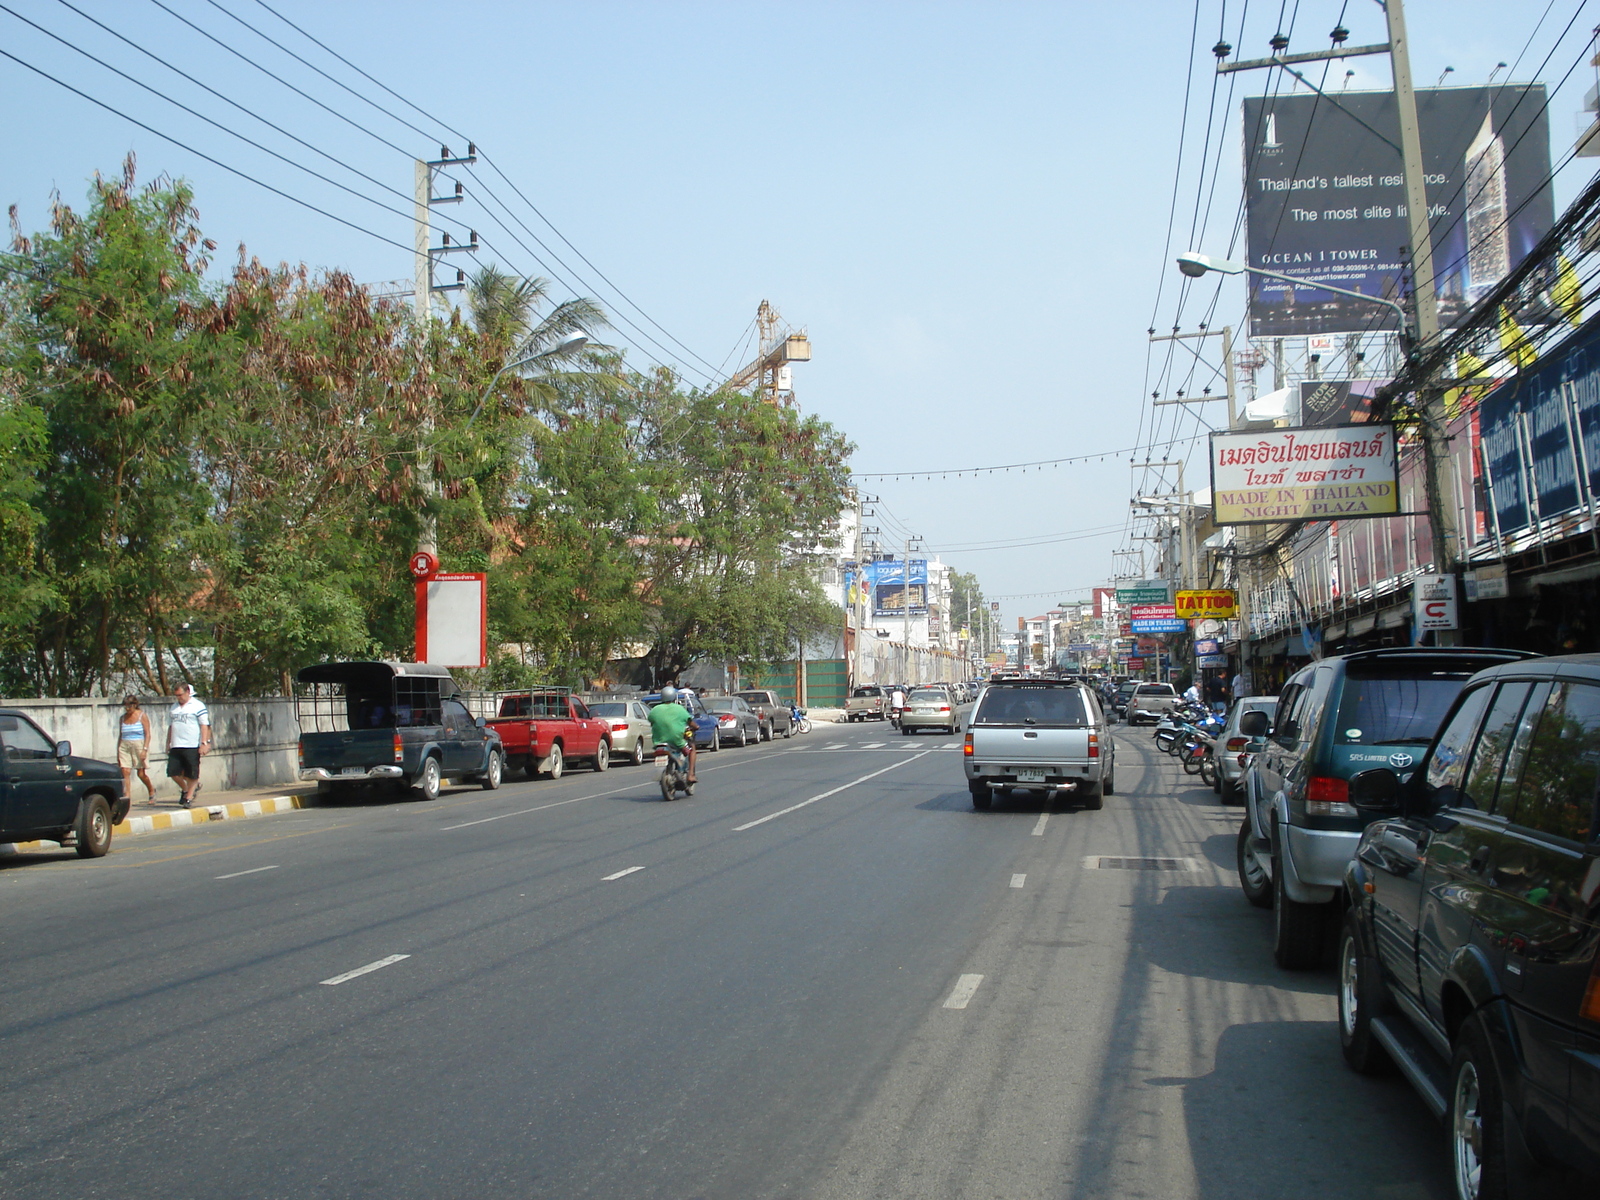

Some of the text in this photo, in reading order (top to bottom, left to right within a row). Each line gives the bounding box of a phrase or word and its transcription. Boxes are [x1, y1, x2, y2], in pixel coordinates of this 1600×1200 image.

[1258, 173, 1450, 192] Thailand's tallest resince.
[1291, 208, 1318, 221] The
[1323, 207, 1358, 220] most
[1364, 205, 1392, 218] elite
[1261, 249, 1378, 264] OCEAN 1 TOWER
[1286, 266, 1311, 275] contact
[1263, 284, 1293, 292] Jomtien,
[1306, 382, 1329, 407] SHOW
[1312, 386, 1337, 412] UNITS
[1219, 431, 1387, 467] เมดอินไทยแลนด์
[1244, 464, 1366, 486] ไนท์ พลาซ่า
[1221, 483, 1391, 506] MADE IN THAILAND
[1243, 501, 1369, 518] NIGHT PLAZA
[1177, 595, 1233, 609] TATTOO
